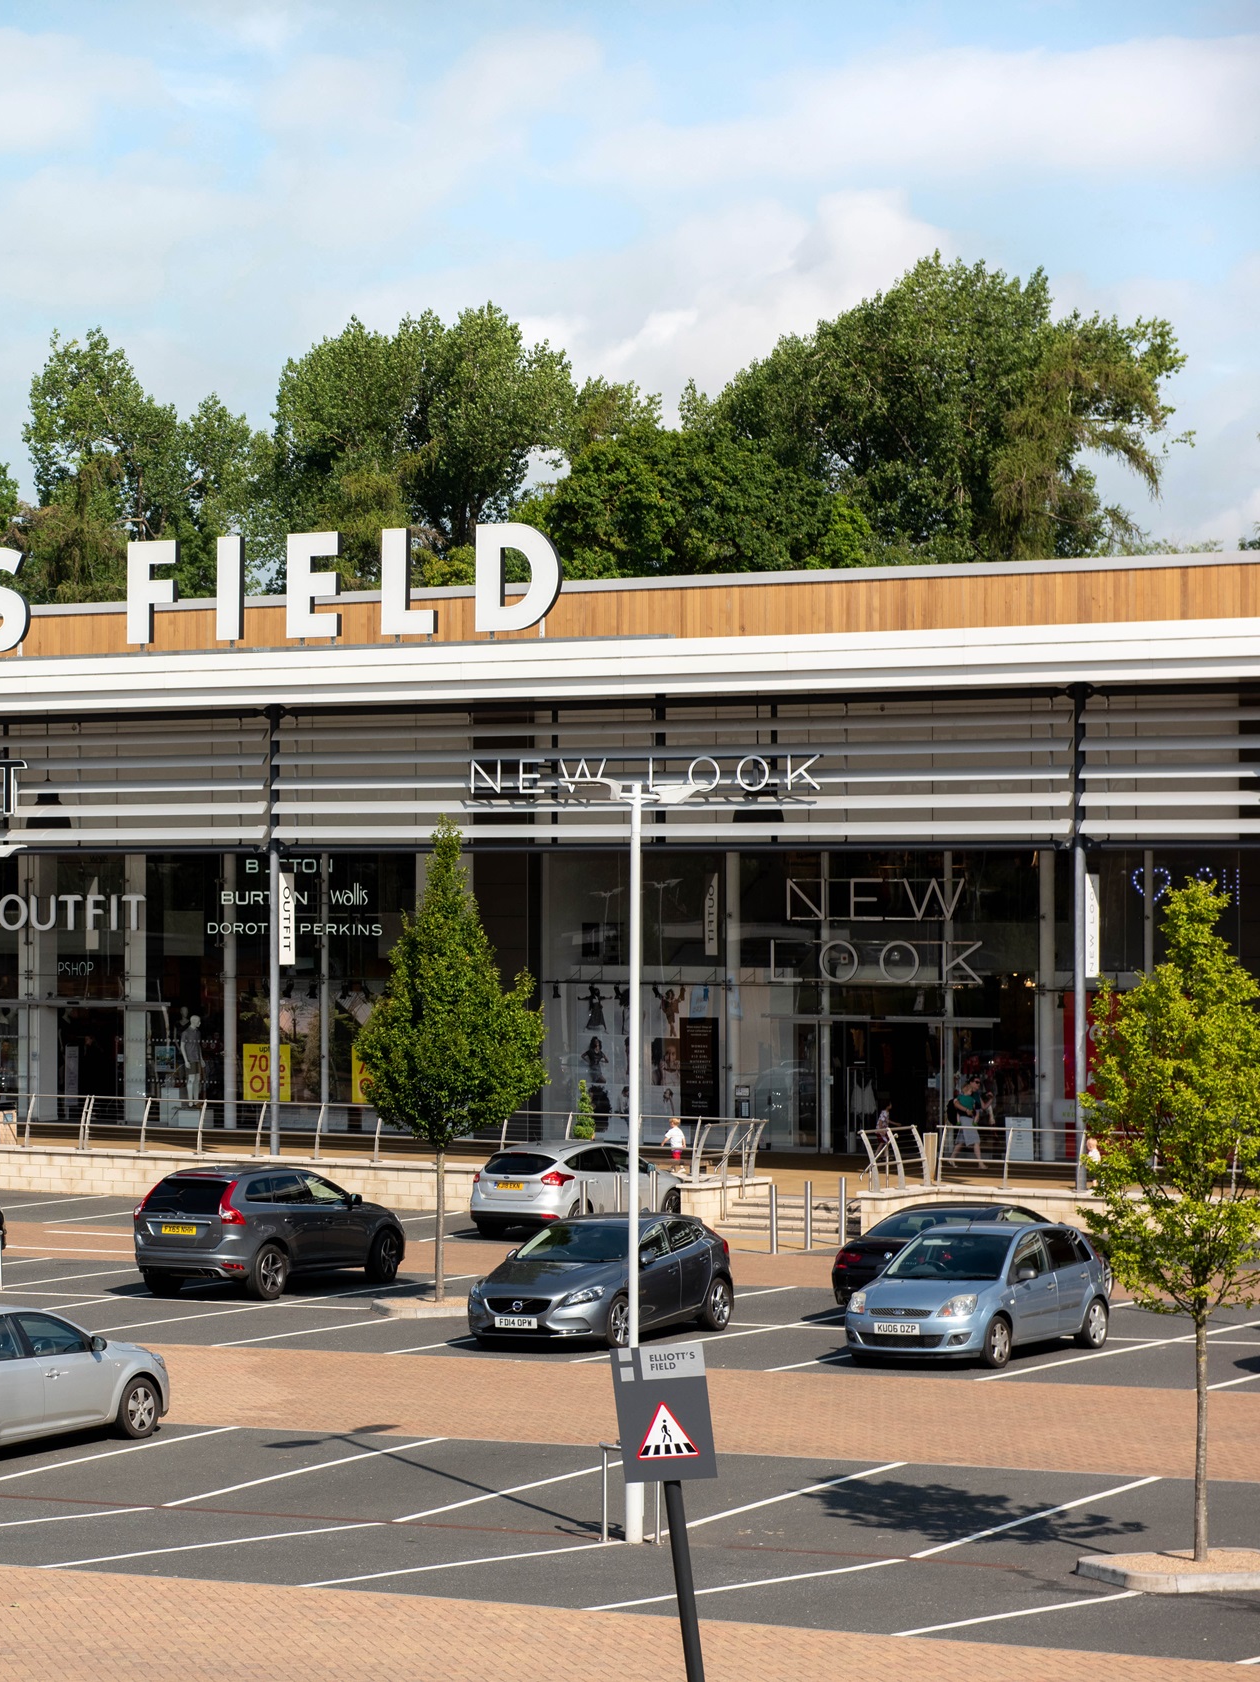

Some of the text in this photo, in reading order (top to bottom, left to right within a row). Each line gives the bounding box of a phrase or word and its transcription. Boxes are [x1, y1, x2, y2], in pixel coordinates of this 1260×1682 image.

[126, 522, 562, 645] FIELD
[471, 754, 824, 794] NEW LOOK
[786, 878, 966, 921] NEW
[207, 922, 383, 936] DOROT PERKINS
[283, 886, 291, 952] OUTFIT
[770, 939, 983, 985] LOOK
[499, 1318, 516, 1326] FD14
[877, 1324, 916, 1333] KU06 OZP
[649, 1351, 696, 1363] ELLIOTT'S
[650, 1362, 677, 1371] FIELD
